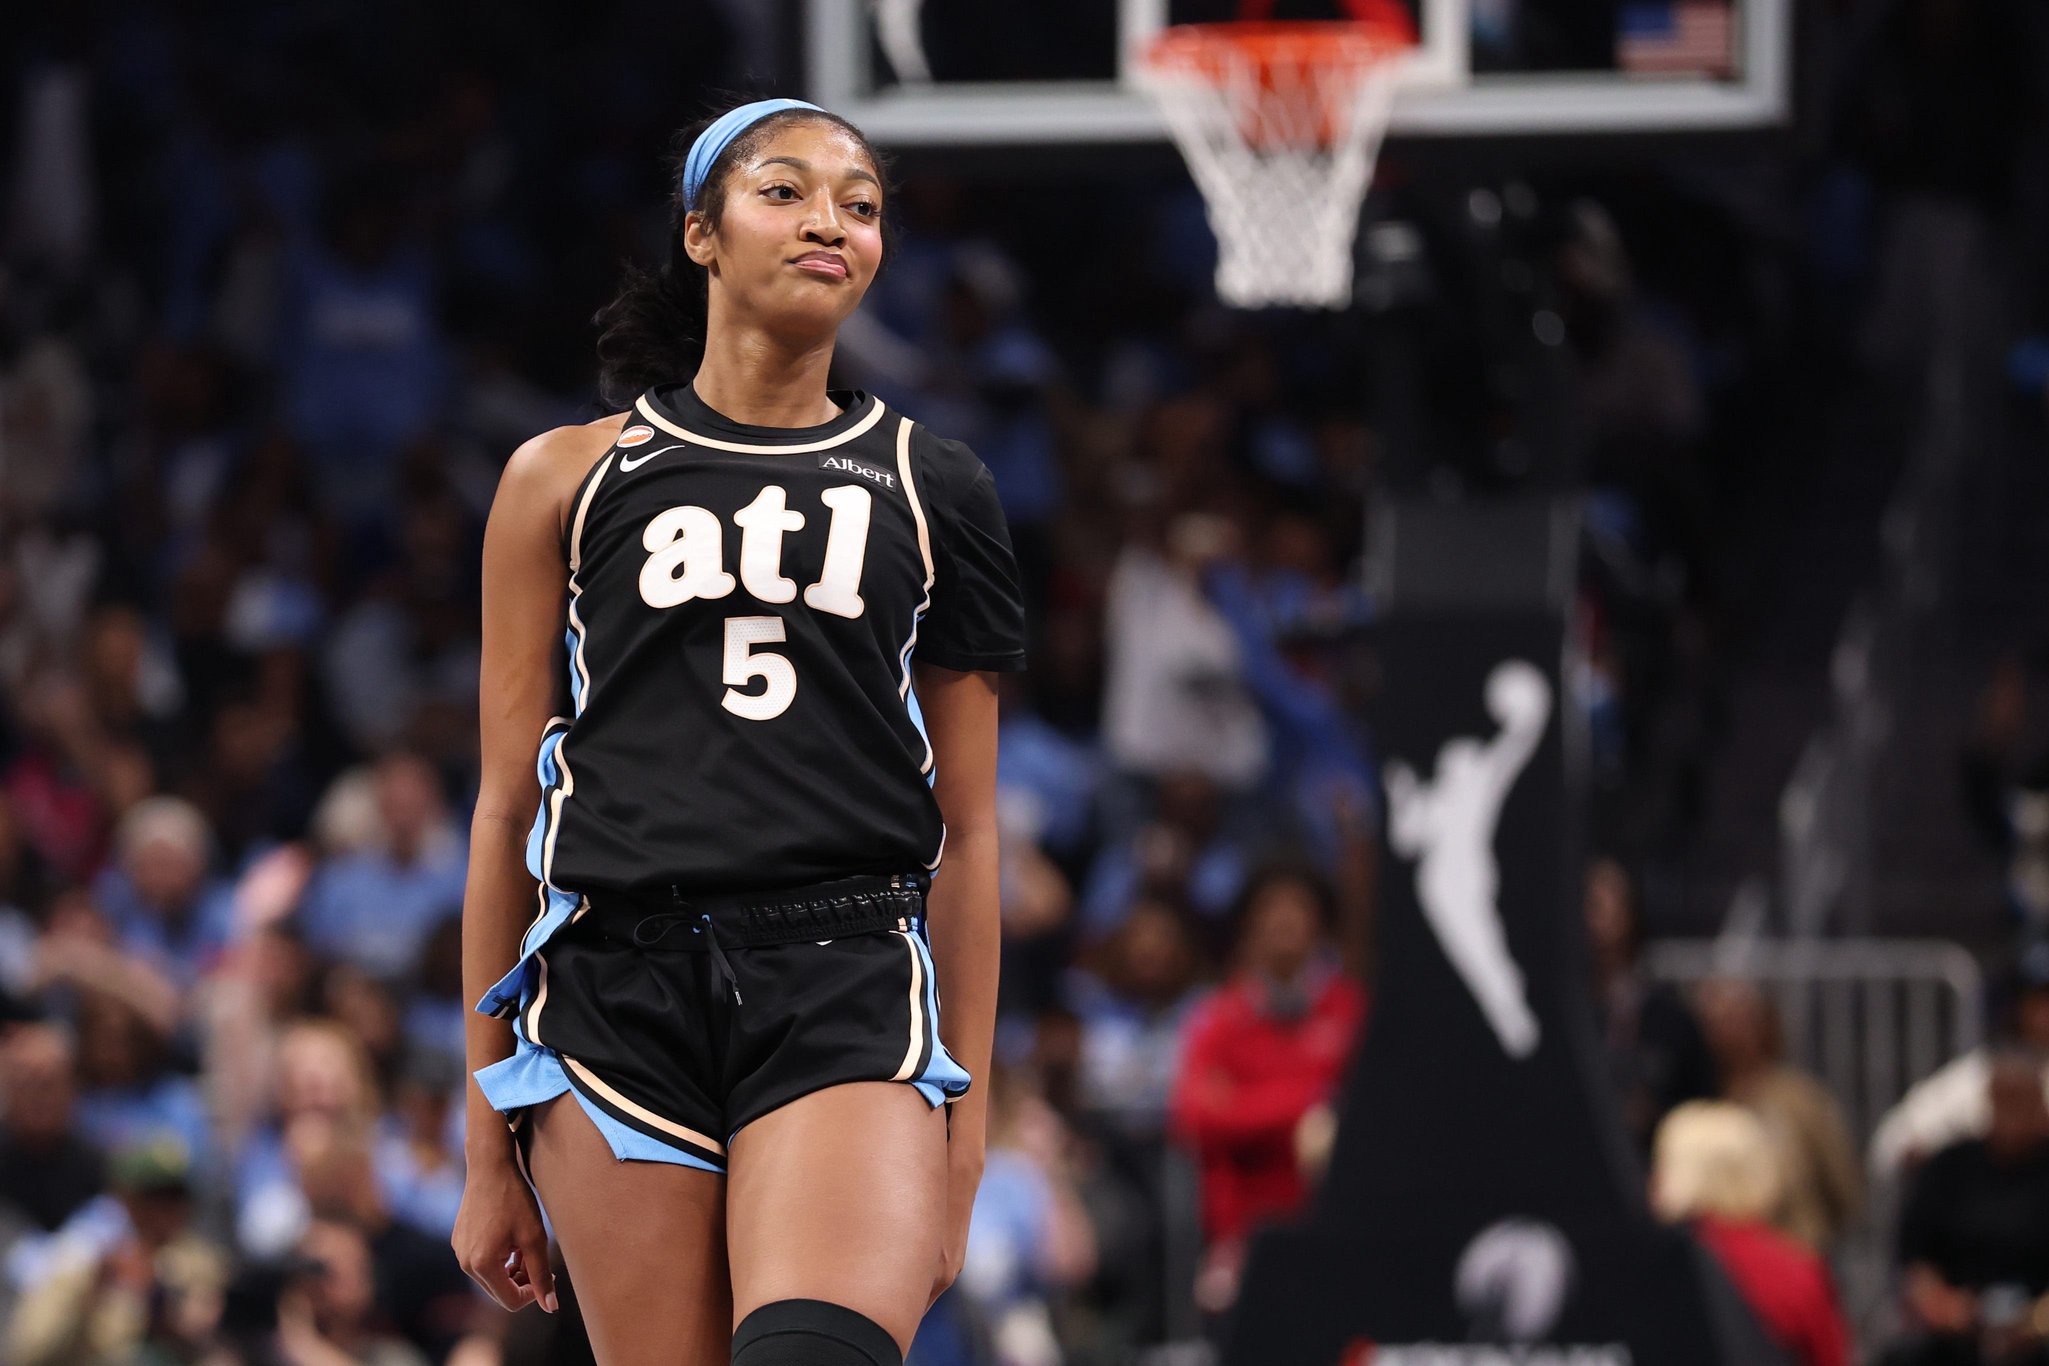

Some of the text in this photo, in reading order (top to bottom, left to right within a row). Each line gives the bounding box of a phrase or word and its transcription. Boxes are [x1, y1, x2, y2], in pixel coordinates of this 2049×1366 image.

[822, 456, 894, 488] Albert
[638, 484, 873, 619] atl
[721, 616, 797, 721] 5
